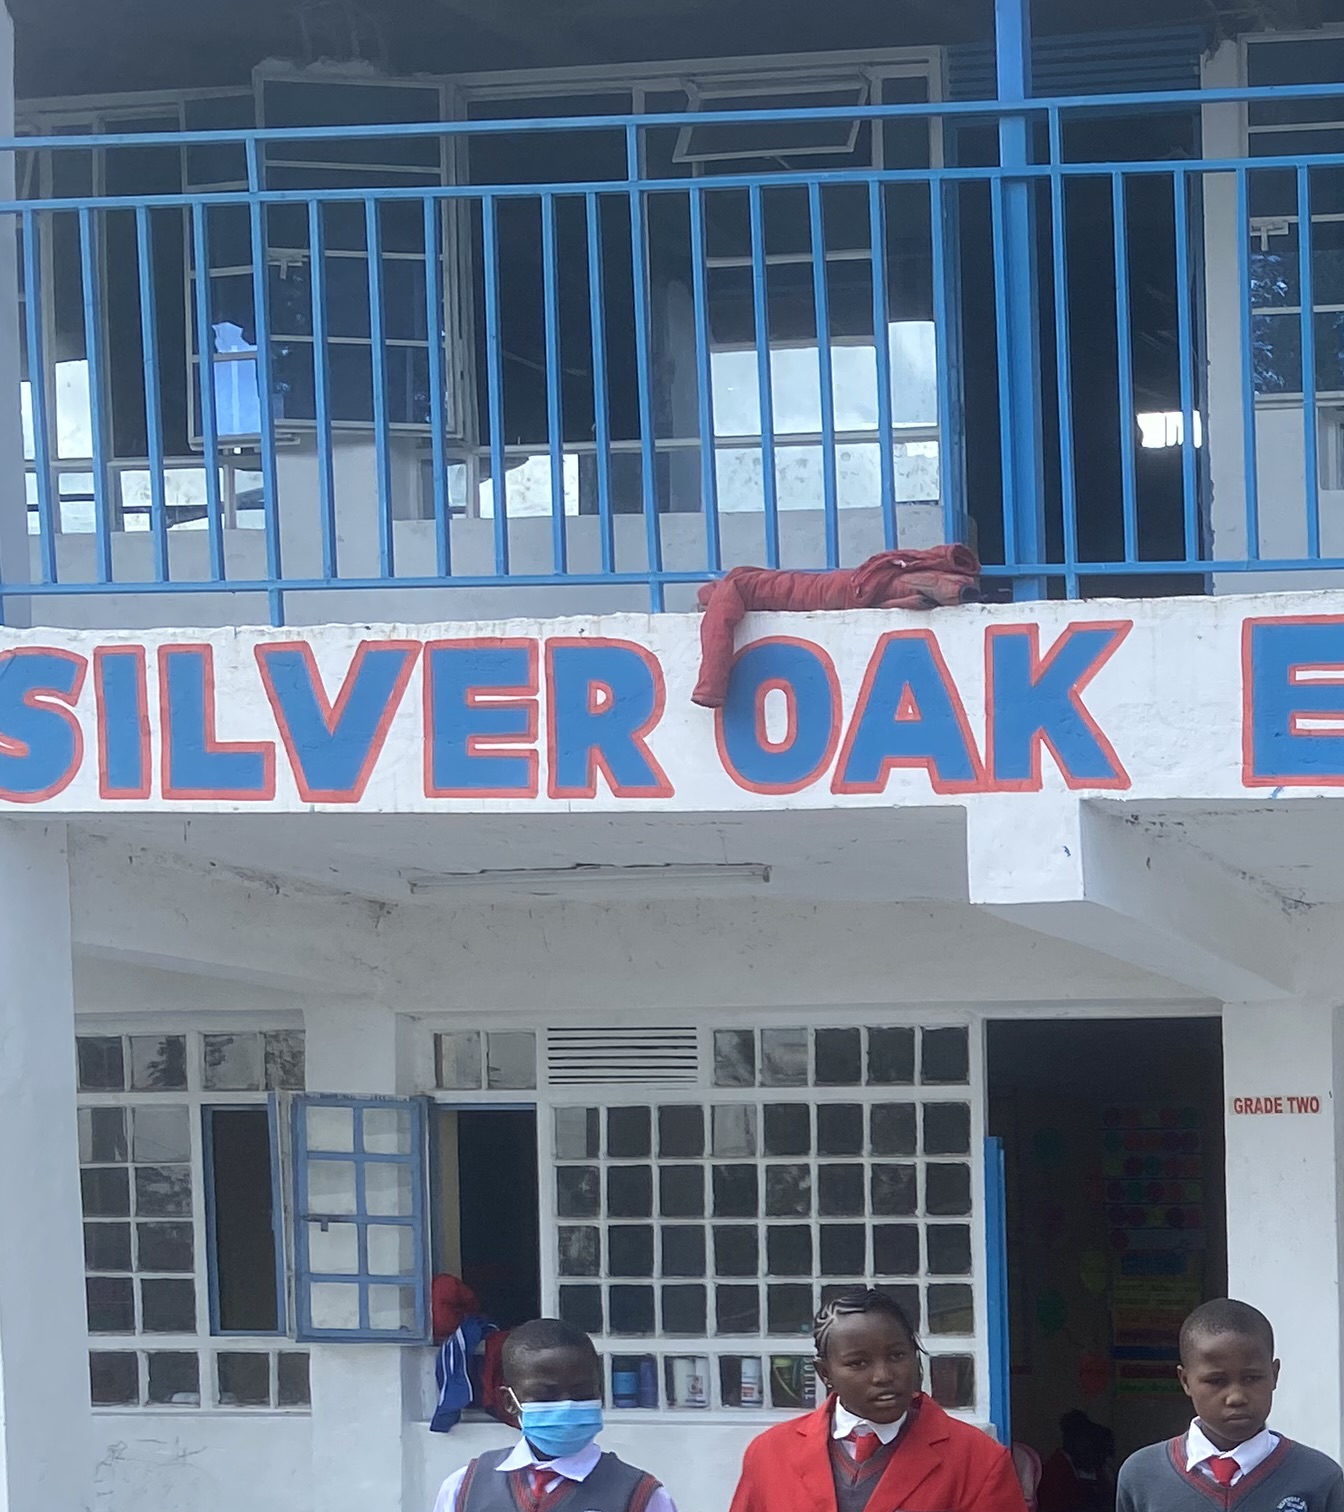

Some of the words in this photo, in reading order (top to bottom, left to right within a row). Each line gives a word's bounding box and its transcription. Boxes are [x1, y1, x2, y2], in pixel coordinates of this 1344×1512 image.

[0, 637, 673, 803] SILVER
[714, 619, 1132, 797] OAK
[1233, 1097, 1283, 1115] GRADE
[1286, 1096, 1320, 1114] TWO
